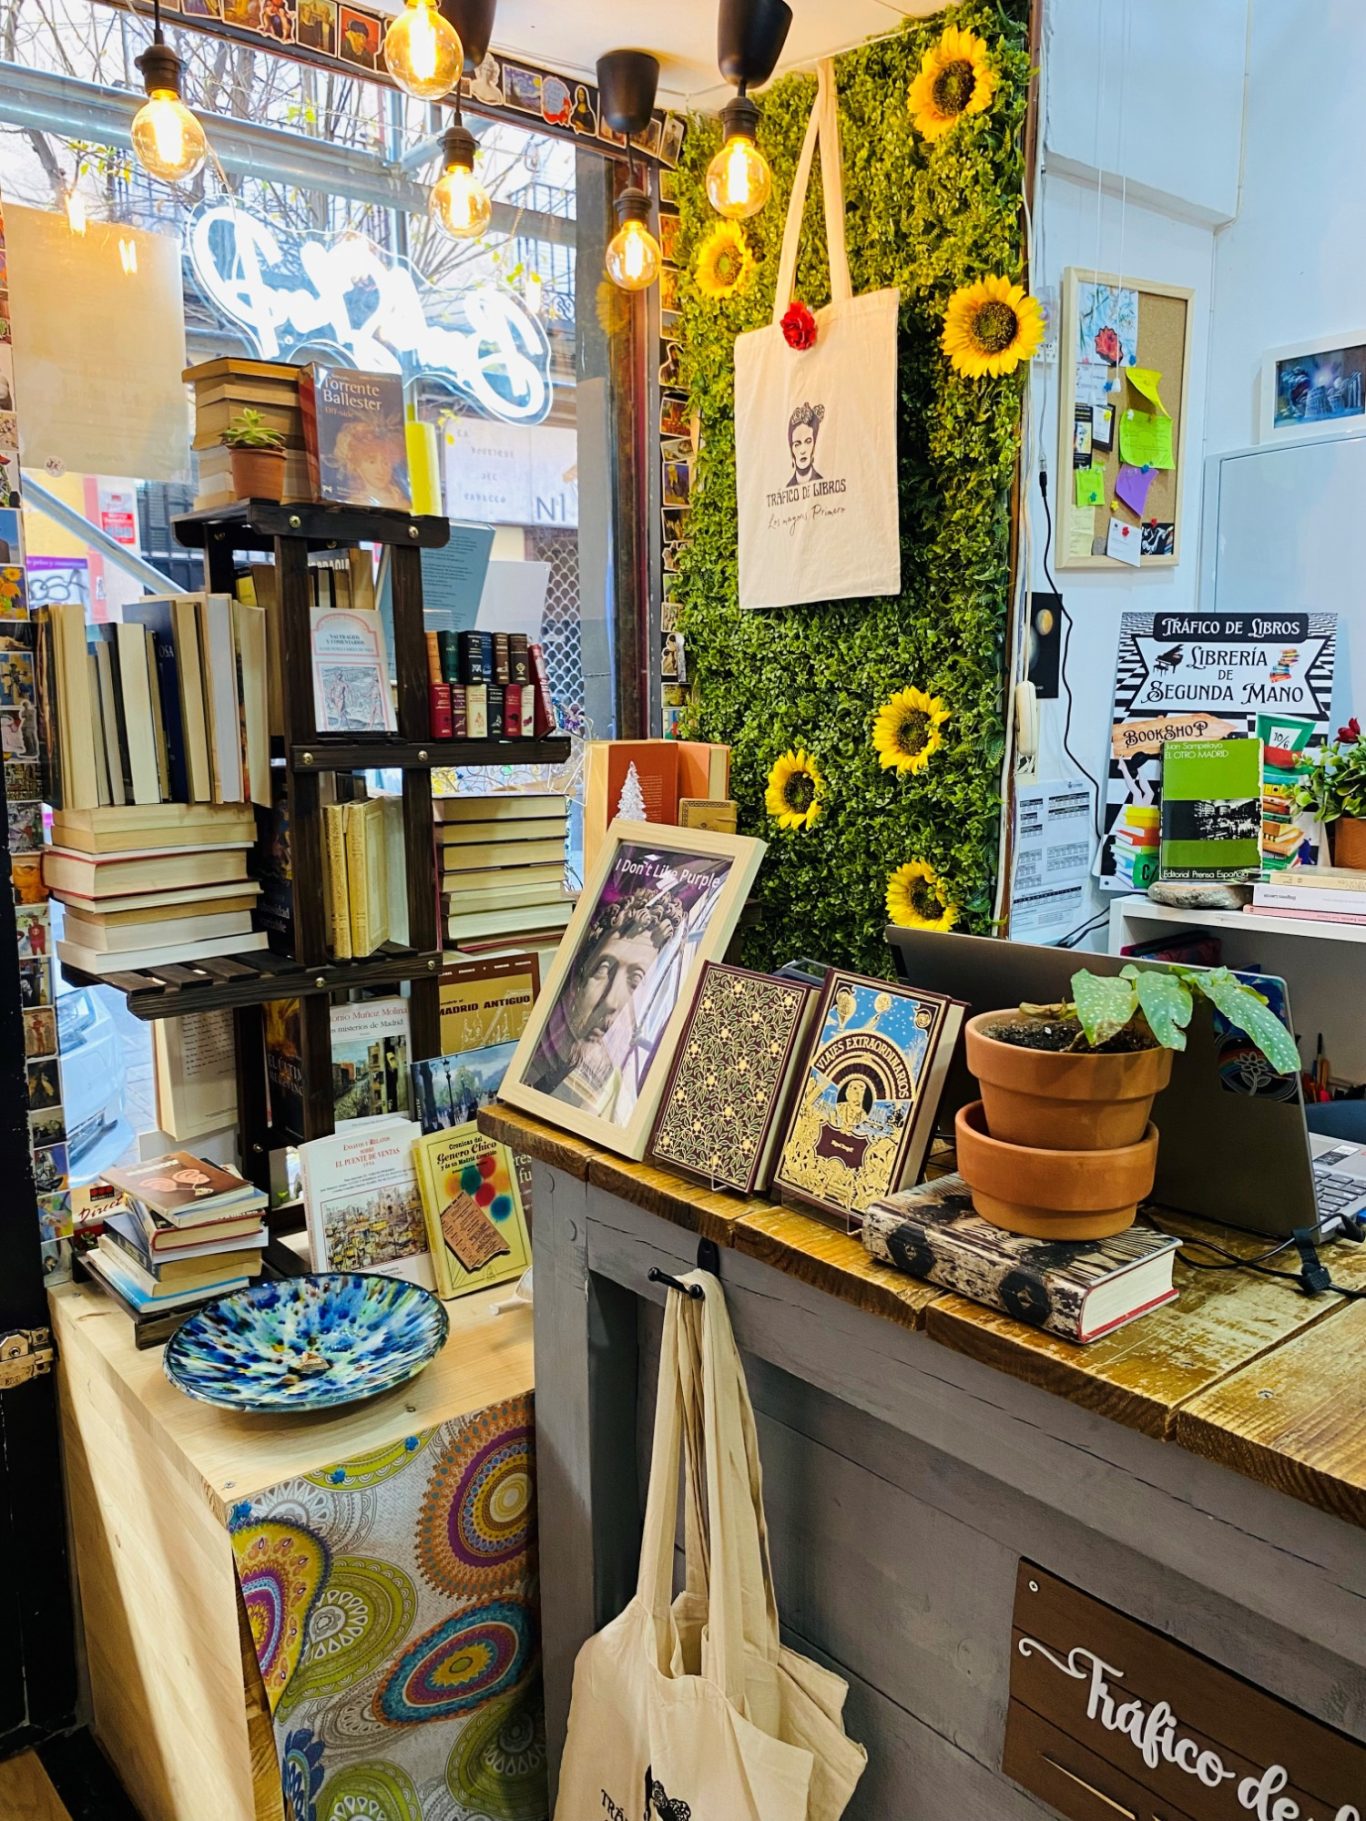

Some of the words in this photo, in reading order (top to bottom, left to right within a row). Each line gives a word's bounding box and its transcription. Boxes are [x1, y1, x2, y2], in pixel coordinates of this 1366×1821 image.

[324, 378, 380, 397] Torrente
[323, 389, 382, 410] Ballester
[767, 487, 799, 507] TRÁFICO
[813, 479, 846, 497] LIBROS
[1162, 617, 1220, 637] TRÁFICO
[1225, 621, 1243, 635] DE
[1248, 617, 1300, 639] LIBROS
[1186, 645, 1268, 670] LIBRERÍA
[1218, 669, 1233, 681] DE
[1141, 680, 1234, 704] SEGUNDA
[1241, 682, 1304, 705] MANO
[1164, 750, 1172, 759] EL
[1174, 750, 1196, 759] OTRO
[1198, 750, 1229, 759] MADRID
[1183, 742, 1223, 753] Sampelayo
[616, 858, 622, 871] I
[622, 859, 652, 876] Don't
[653, 864, 678, 879] Like
[680, 868, 720, 890] Purple
[1163, 869, 1190, 878] Editorial
[1192, 870, 1215, 879] Prensa
[484, 995, 531, 1009] ANTIGUO
[352, 1009, 380, 1020] Muñoz
[382, 1006, 408, 1016] Molina
[337, 1024, 368, 1032] misterios
[369, 1021, 379, 1029] de
[380, 1018, 404, 1027] Madrid
[815, 1040, 845, 1072] VIAJES
[845, 1036, 910, 1099] EXTRAORDINARIOS
[474, 1135, 483, 1143] del
[471, 1141, 497, 1154] Chico
[1019, 1638, 1235, 1787] Tráfico
